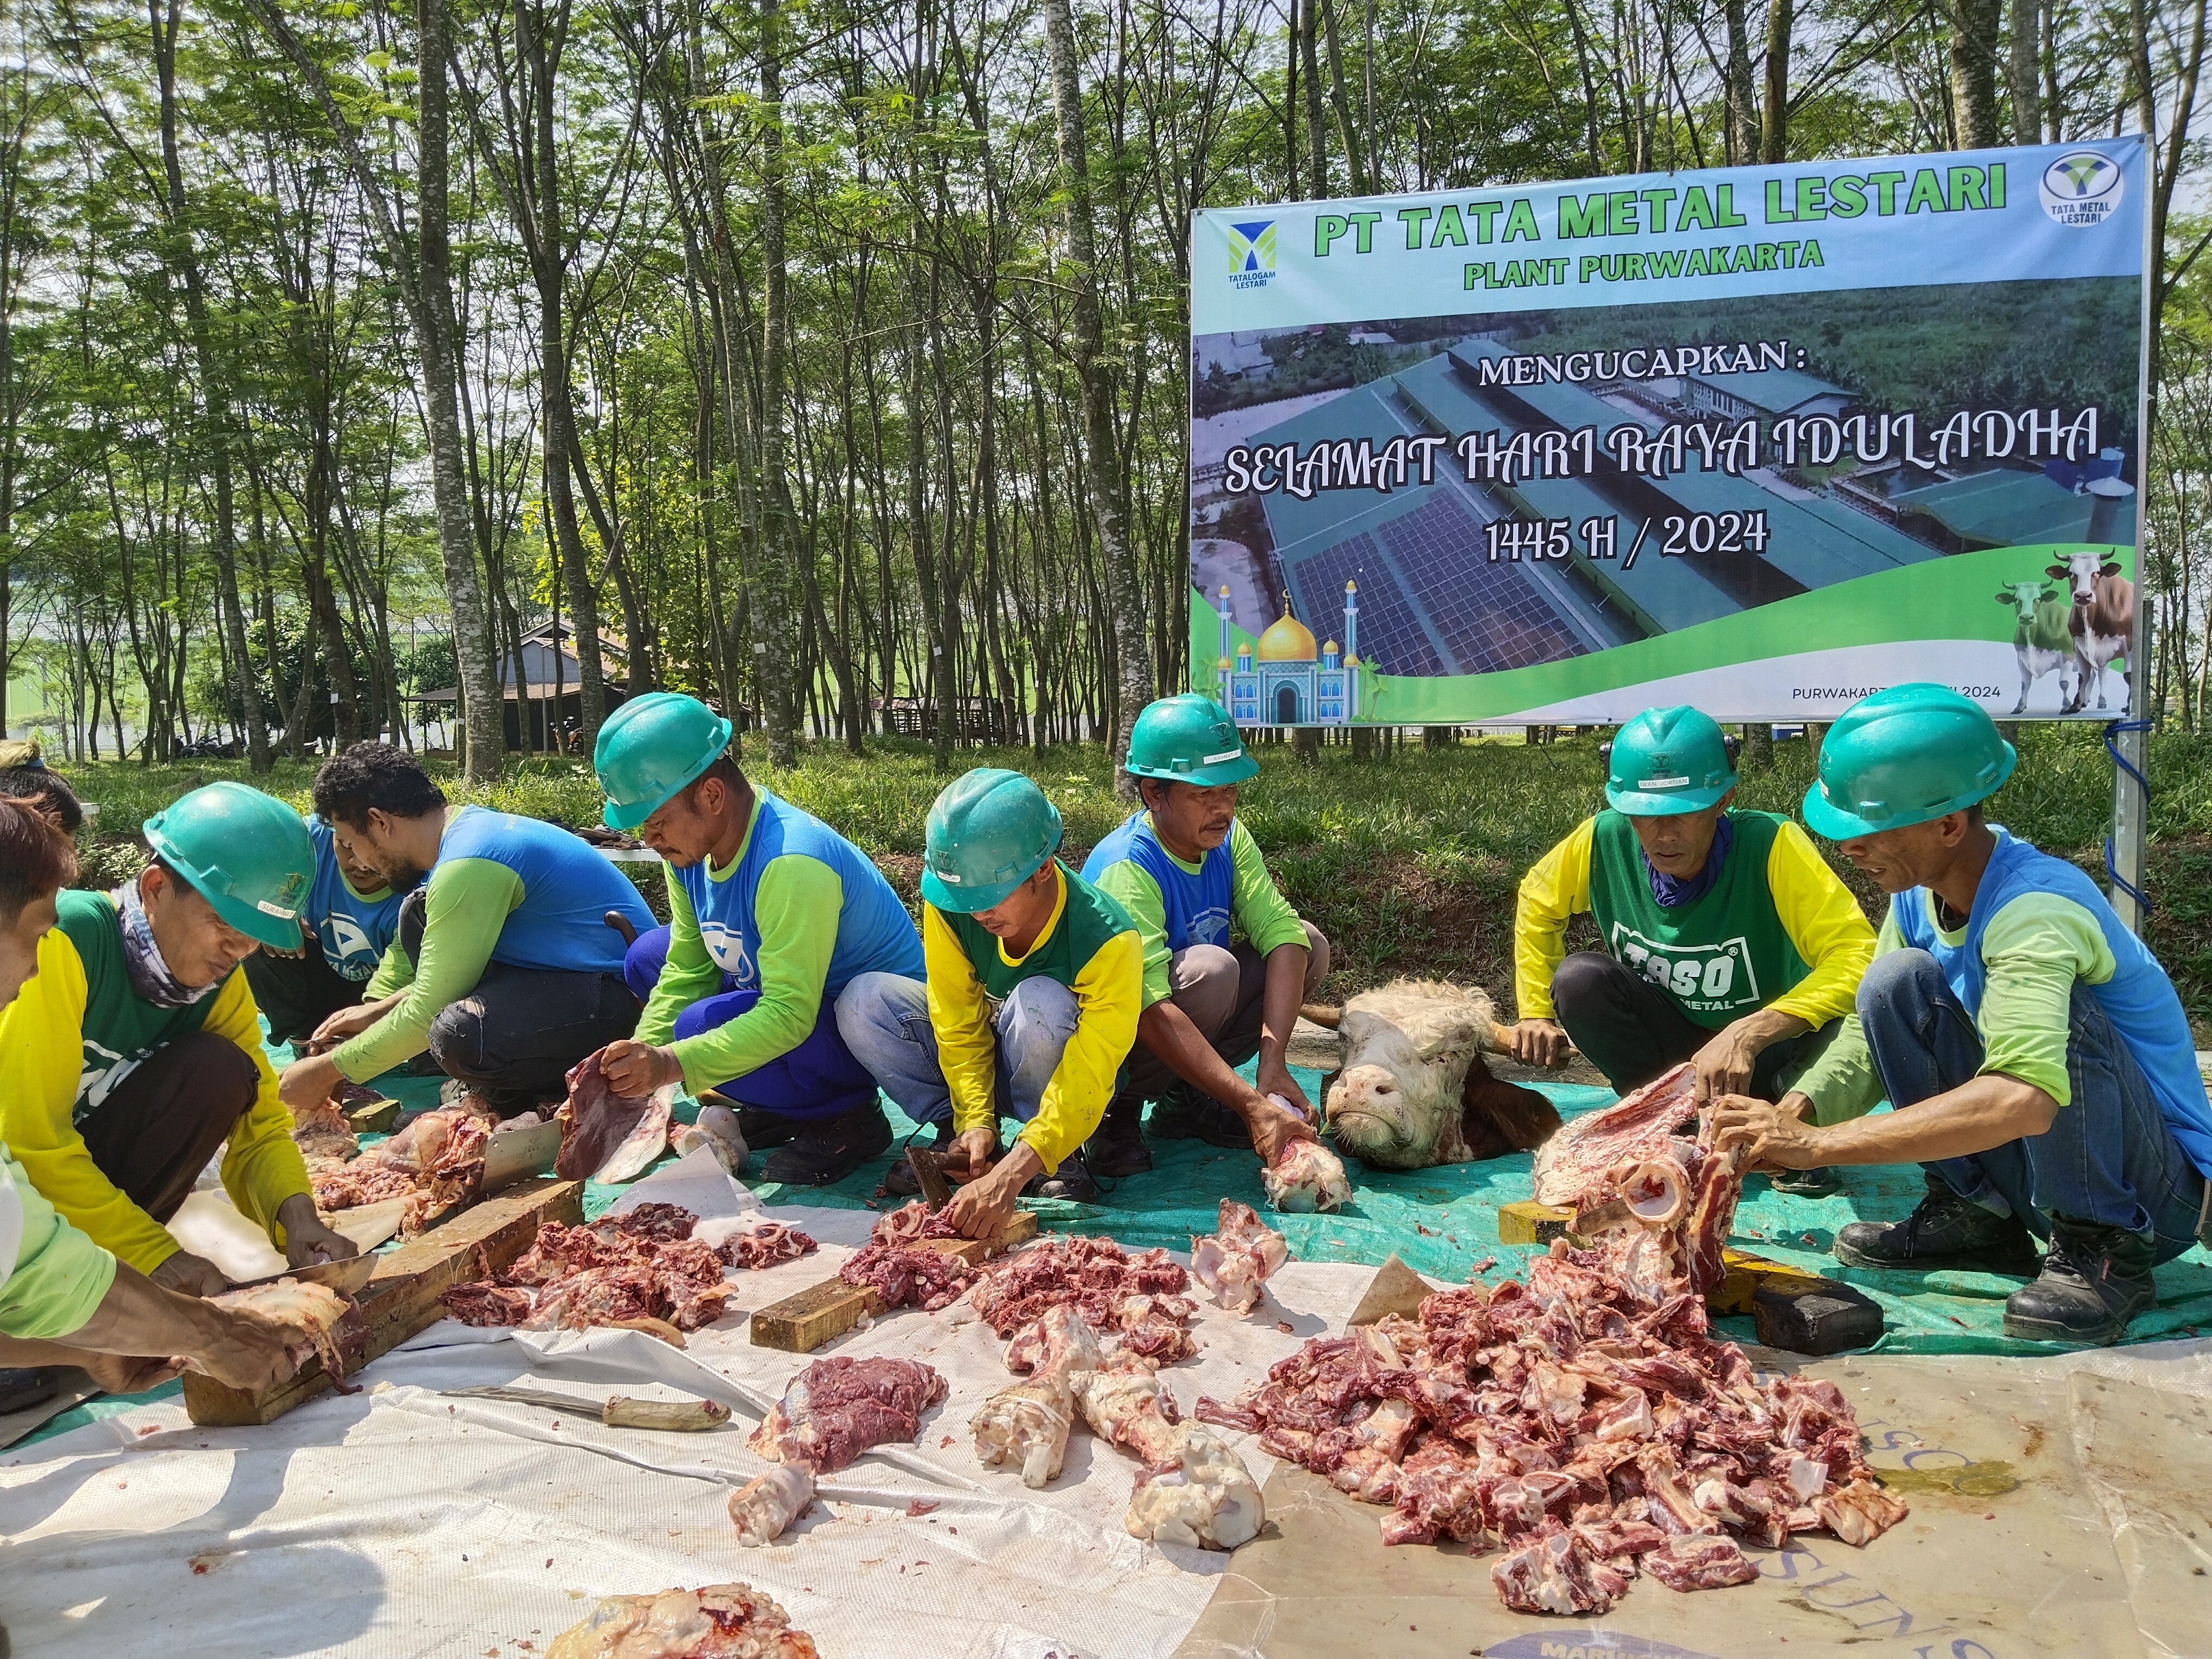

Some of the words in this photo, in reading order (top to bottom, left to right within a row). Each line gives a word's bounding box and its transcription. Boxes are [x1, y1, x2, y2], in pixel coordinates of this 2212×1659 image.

[1314, 211, 1382, 258] PT
[1397, 198, 1541, 250] TATA
[1557, 183, 1747, 240] METAL
[1764, 162, 2007, 224] LESTARI
[2050, 204, 2075, 215] TATA
[2079, 202, 2112, 213] METAL
[2061, 213, 2101, 224] LESTARI
[1463, 257, 1570, 291] PLANT
[1579, 239, 1825, 284] PURWAKARTA
[1228, 271, 1276, 282] TATALOGAM
[1236, 279, 1267, 290] LESTARI
[1224, 434, 1448, 500] SELAMAT
[1457, 424, 1596, 487] HARI
[1607, 416, 1760, 480] RAYA
[1772, 413, 1935, 471] IDUL
[1929, 407, 2098, 465] ADHA
[1482, 516, 1572, 564] 1445
[1578, 512, 1618, 560] H
[1624, 517, 1651, 569] /
[1661, 511, 1770, 556] 2024
[1964, 685, 2001, 697] 2024
[1660, 778, 1688, 787] JORDAN
[1624, 942, 1734, 998] TASO
